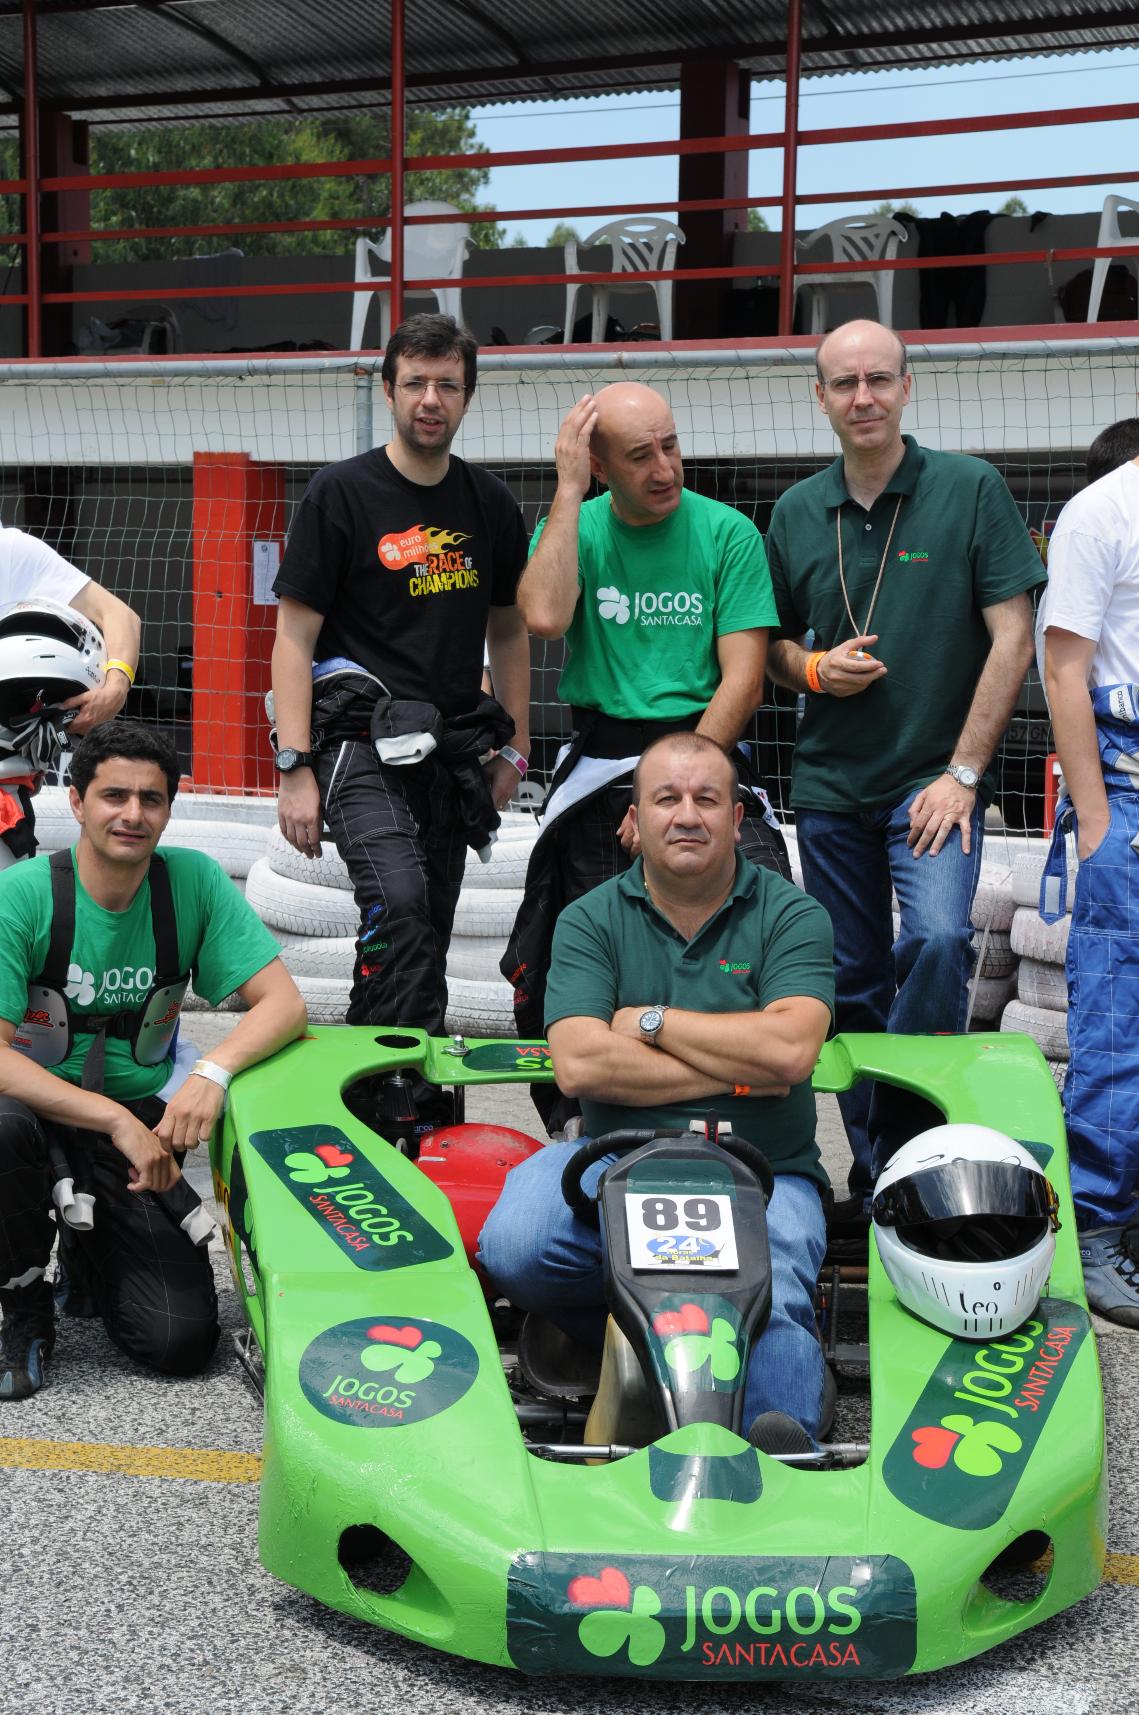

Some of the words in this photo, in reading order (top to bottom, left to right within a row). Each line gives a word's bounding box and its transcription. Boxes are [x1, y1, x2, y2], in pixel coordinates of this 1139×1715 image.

[400, 535, 422, 548] euro
[414, 563, 428, 577] THE
[427, 551, 466, 575] RACE
[464, 556, 473, 570] OF
[409, 569, 479, 597] CHAMPIONS
[634, 591, 703, 620] JOGOS
[640, 615, 703, 626] SANTACASA
[309, 1195, 370, 1252] SANTACASA
[313, 1183, 414, 1246] JOGOS
[641, 1197, 722, 1231] 89
[656, 1236, 701, 1253] 24
[1014, 1326, 1078, 1412] SANTACASA
[323, 1375, 417, 1408] JOGOS
[329, 1394, 404, 1419] SANTACASA
[680, 1585, 862, 1652] JOGOS
[702, 1642, 861, 1667] SANTACASA
